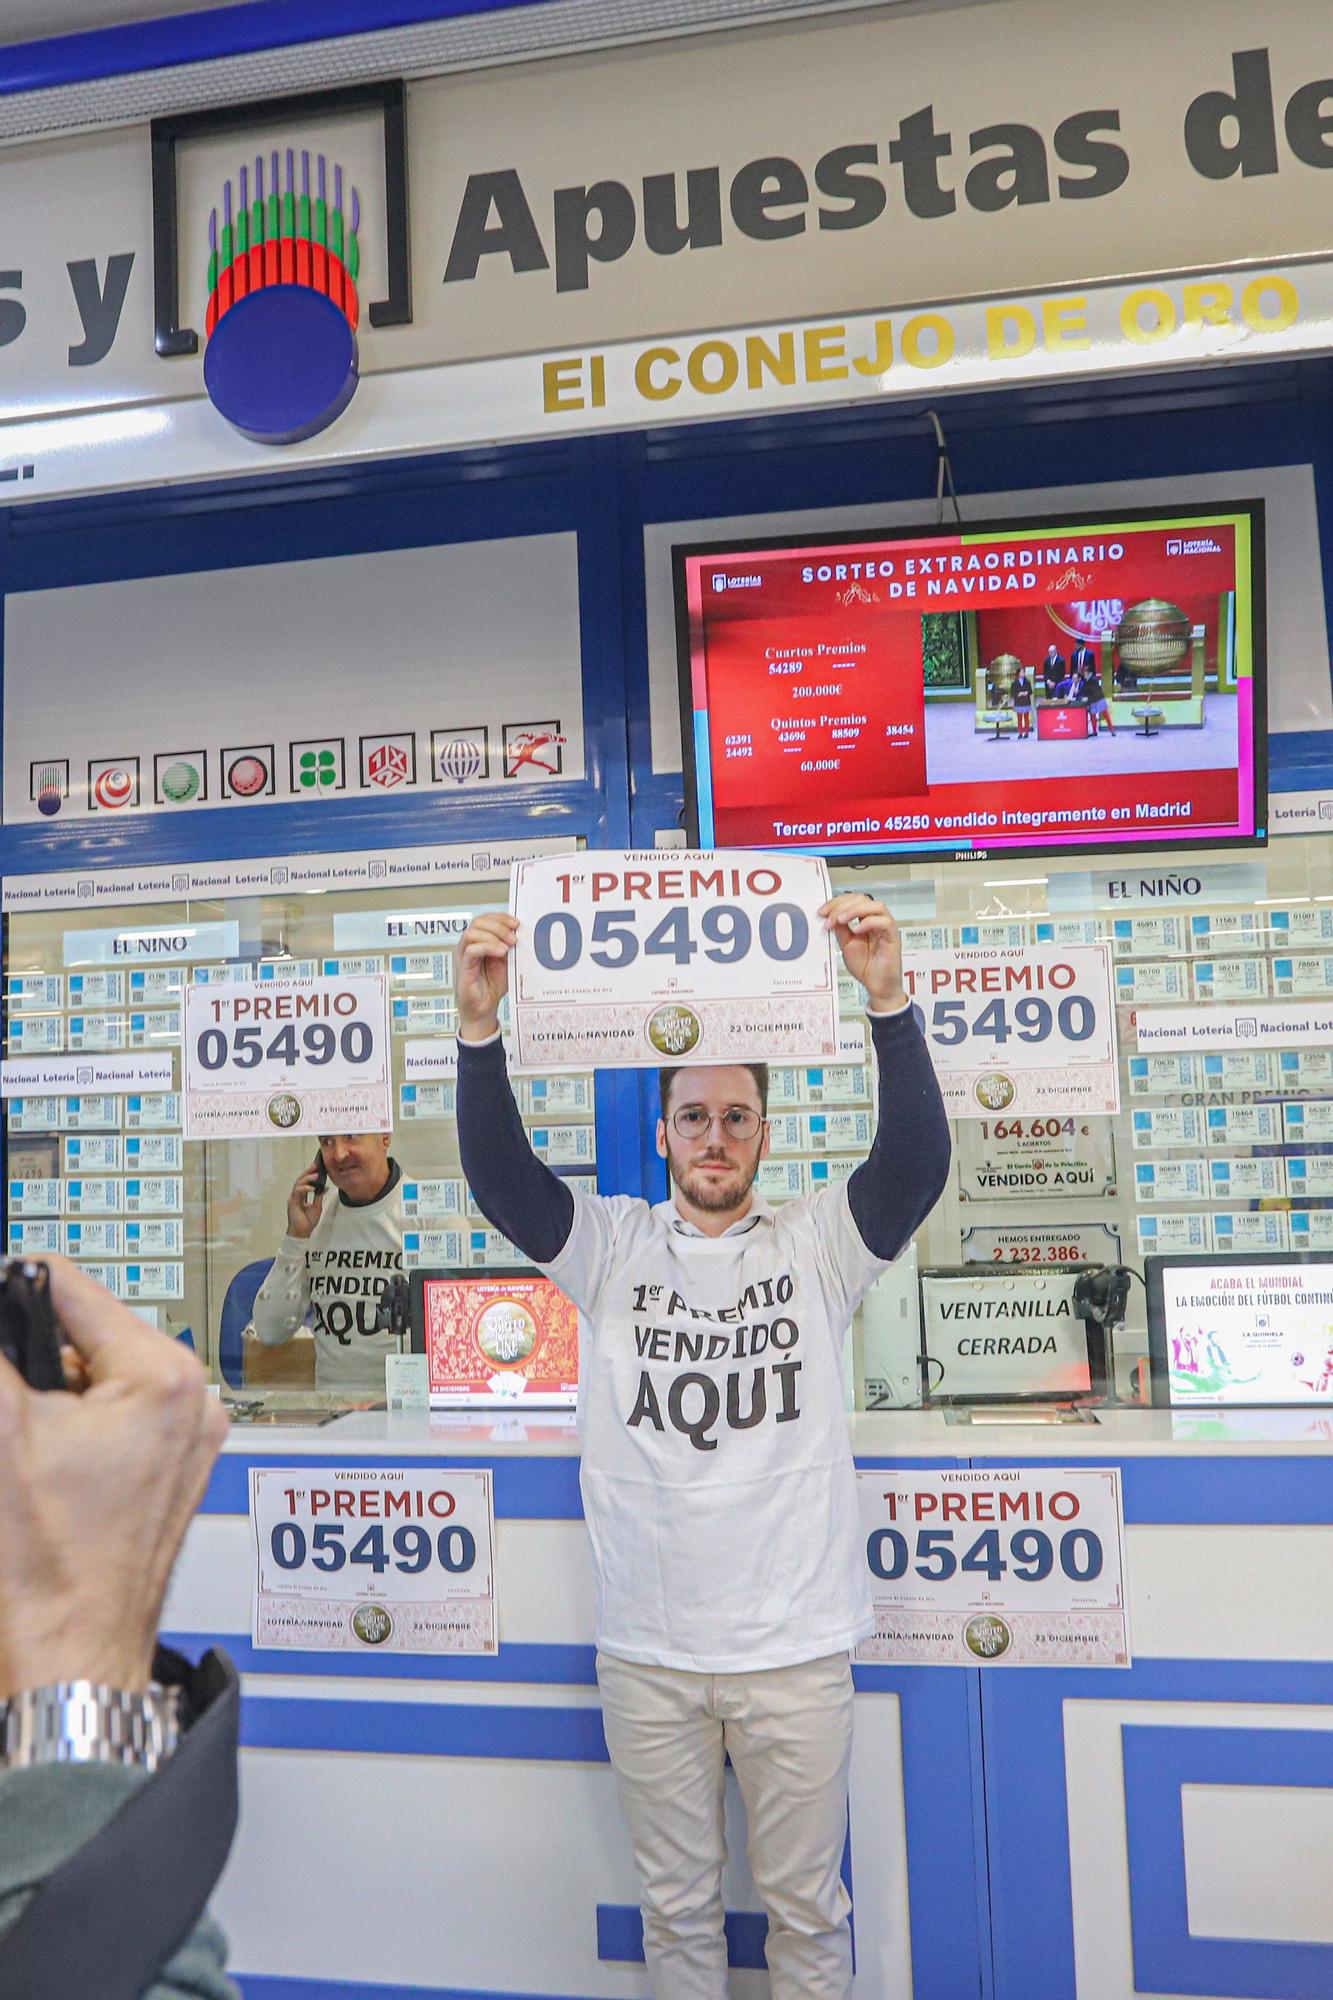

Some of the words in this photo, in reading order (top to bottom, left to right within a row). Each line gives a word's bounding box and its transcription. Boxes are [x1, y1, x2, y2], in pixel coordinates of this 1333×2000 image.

[67, 252, 135, 367] y
[443, 104, 1130, 293] Apuestas
[1184, 47, 1333, 179] de
[634, 314, 955, 400] CONEJO
[986, 297, 1091, 361] DE
[1120, 276, 1299, 345] ORO
[802, 560, 895, 584] SORTEO
[905, 543, 1125, 576] EXTRAORDINARIO
[889, 582, 917, 599] DE
[927, 572, 1037, 596] NAVIDAD
[765, 647, 813, 659] Cuartos
[817, 641, 867, 656] Premios
[768, 662, 804, 675] 54289
[770, 717, 817, 731] Quintos
[820, 712, 867, 727] Premios
[725, 734, 752, 746] 62391
[778, 732, 806, 743] 43696
[773, 821, 823, 837] Tercer
[826, 819, 881, 837] premio
[884, 815, 930, 831] 45250
[934, 811, 997, 829] vendido
[1110, 807, 1131, 819] en
[1135, 801, 1192, 818] Madrid
[1275, 807, 1316, 819] Lotería
[623, 853, 680, 862] VENDIDO
[955, 850, 988, 861] PHILIPS
[4, 889, 42, 900] Nacional
[44, 886, 76, 898] Lotería
[96, 882, 134, 894] Nacional
[138, 880, 170, 891] Lotería
[192, 875, 231, 887] Nacional
[235, 873, 269, 885] Lotería
[290, 869, 331, 881] Nacional
[333, 866, 367, 878] Lotería
[389, 862, 431, 874] Nacional
[434, 860, 470, 871] Lotería
[591, 868, 783, 902] PREMIO
[1108, 881, 1132, 899] EL
[1140, 873, 1202, 897] NIÑO
[533, 902, 809, 970] 05490
[954, 951, 998, 960] VENDIDO
[1000, 948, 1024, 958] AQUÍ
[931, 963, 1076, 994] PREMIO
[233, 992, 358, 1021] PREMIO
[532, 1030, 575, 1041] LOTERÍA
[586, 1029, 635, 1039] NAVIDAD
[730, 1024, 742, 1033] 22
[745, 1022, 804, 1032] DICIEMBRE
[1138, 1027, 1187, 1039] Nacional
[1192, 1024, 1233, 1036] Lotería
[1260, 1021, 1309, 1033] Nacional
[197, 1021, 374, 1070] 05490
[406, 1056, 449, 1067] Nacional
[2, 1074, 40, 1085] Nacional
[43, 1072, 75, 1083] Lotería
[95, 1069, 134, 1080] Nacional
[138, 1068, 171, 1079] Lotería
[1181, 1091, 1235, 1107] GRAN
[980, 1117, 1076, 1140] 164.604
[977, 1172, 1048, 1187] VENDIDO
[1054, 1167, 1095, 1185] AQUÍ
[998, 1235, 1028, 1243] HEMOS
[1030, 1233, 1081, 1242] ENTREGADO
[1210, 1278, 1243, 1290] ACABA
[1245, 1278, 1256, 1289] EL
[1258, 1276, 1304, 1289] MUNDIAL
[940, 1299, 1071, 1320] VENTANILLA
[1176, 1296, 1188, 1308] LA
[1190, 1291, 1236, 1307] EMOCIÓN
[1238, 1294, 1254, 1307] DEL
[1257, 1290, 1292, 1306] FÚTBOL
[313, 1301, 385, 1346] AQU
[634, 1317, 799, 1363] VENDIDO
[957, 1336, 1058, 1357] CERRADA
[626, 1353, 802, 1451] AQUÍ
[334, 1471, 378, 1481] VENDIDO
[379, 1471, 404, 1481] AQUÍ
[940, 1473, 990, 1482] VENDIDO
[993, 1471, 1021, 1482] AQUÍ
[310, 1489, 456, 1519] PREMIO
[914, 1491, 1081, 1521] PREMIO
[270, 1522, 476, 1574] 05490
[866, 1528, 1104, 1582] 05490
[912, 1633, 954, 1641] NAVIDAD
